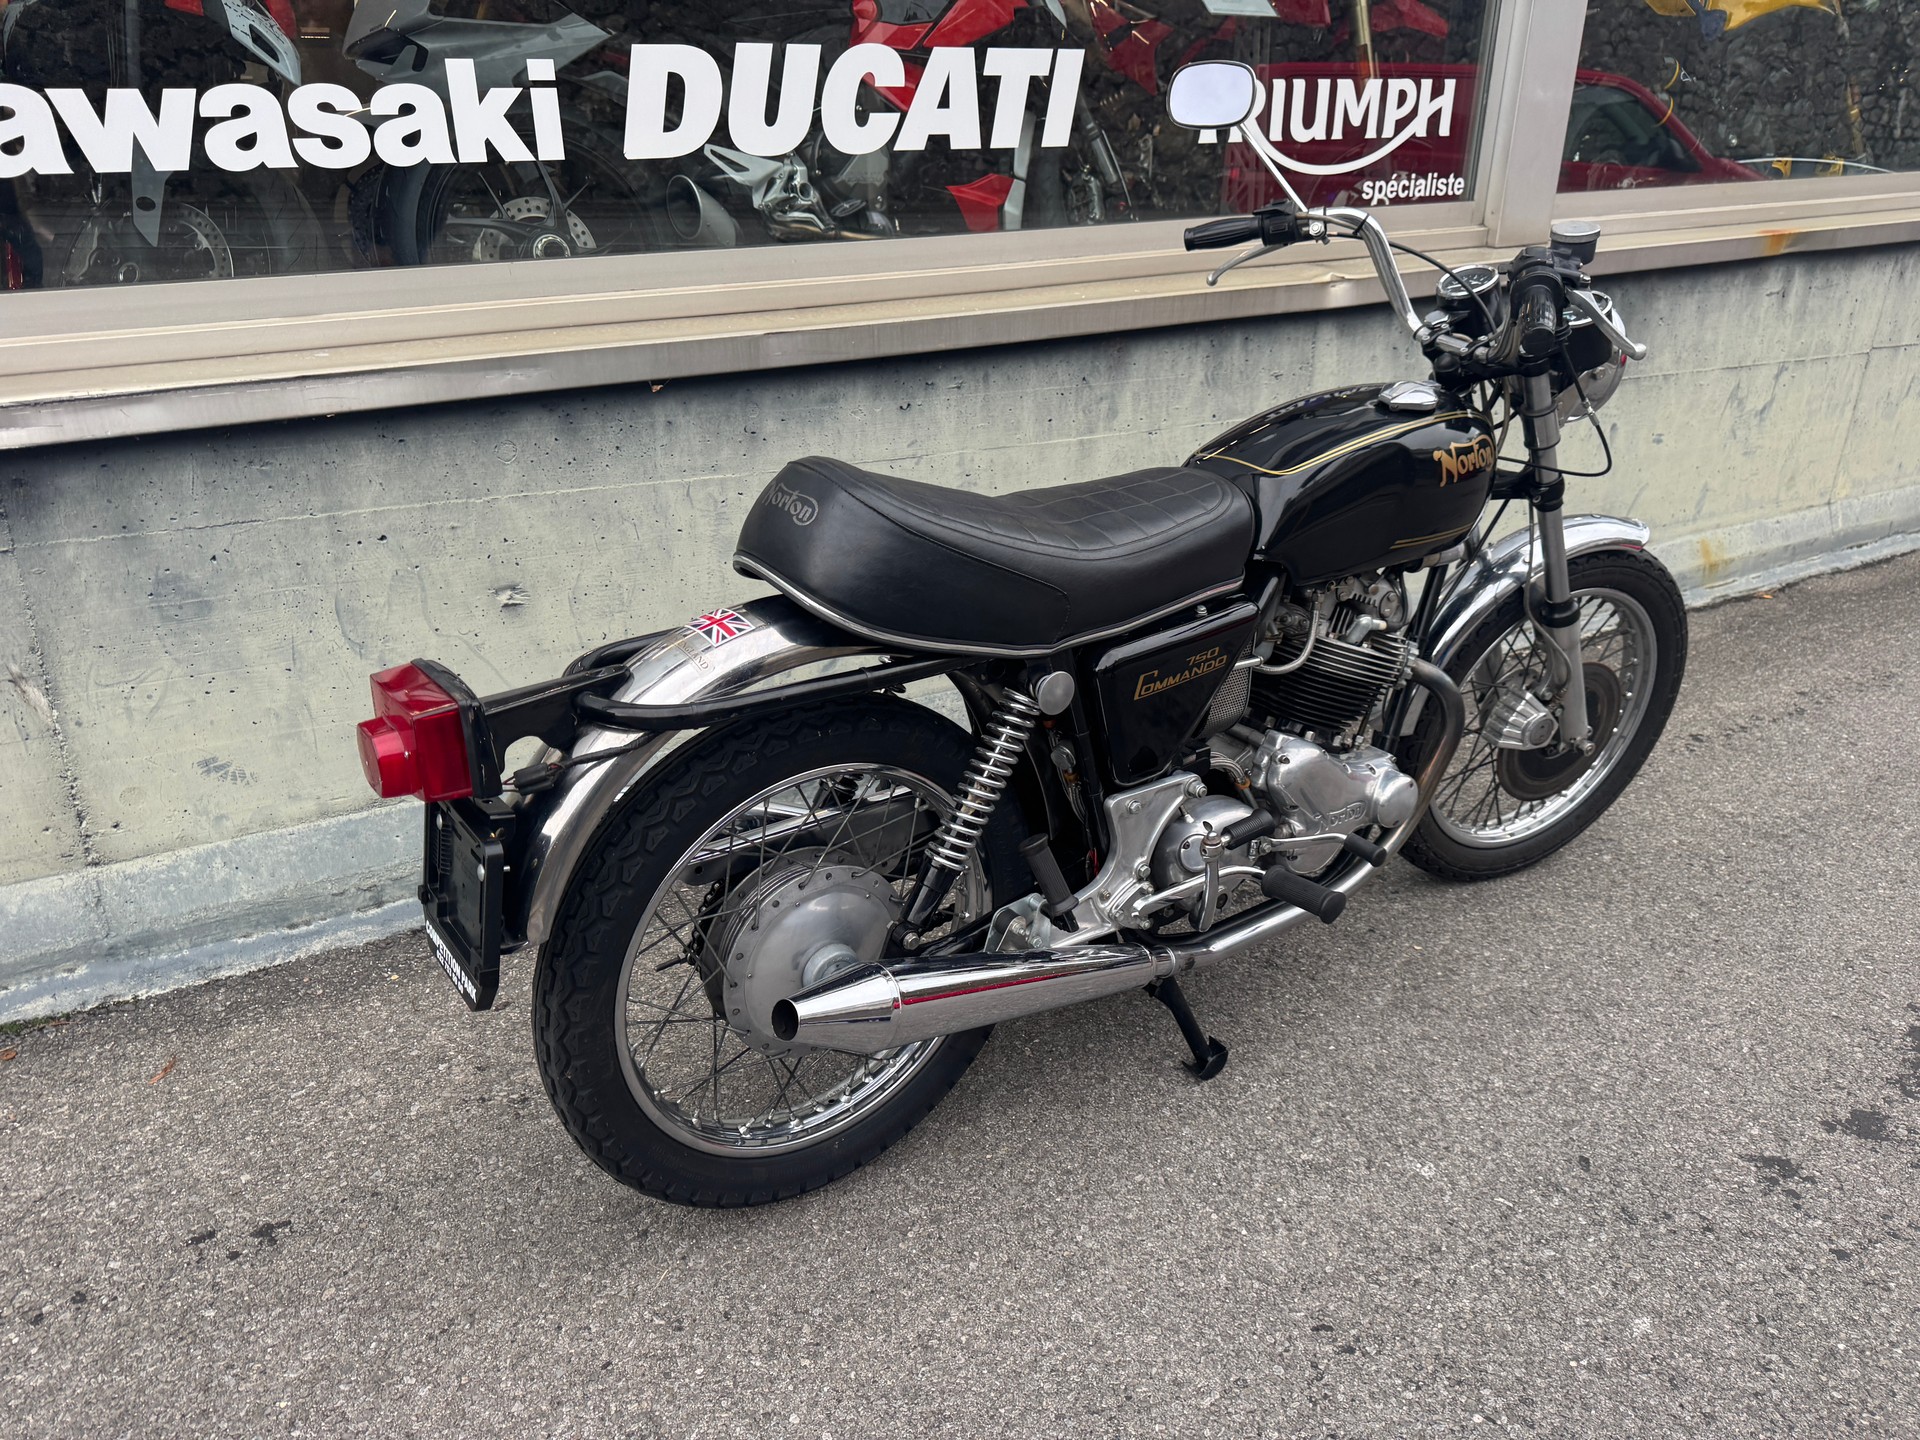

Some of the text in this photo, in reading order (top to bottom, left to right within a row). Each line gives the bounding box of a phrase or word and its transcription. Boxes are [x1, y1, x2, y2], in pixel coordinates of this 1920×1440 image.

[624, 42, 1085, 159] DUCATI
[1198, 78, 1457, 175] RIUMPH
[1361, 172, 1465, 205] spécialiste
[1432, 434, 1495, 487] Norton
[762, 480, 819, 526] Norton
[1134, 655, 1228, 700] COMMANDO
[1186, 646, 1219, 666] 750
[425, 920, 461, 980] COMPETITION
[461, 970, 477, 1003] PARK
